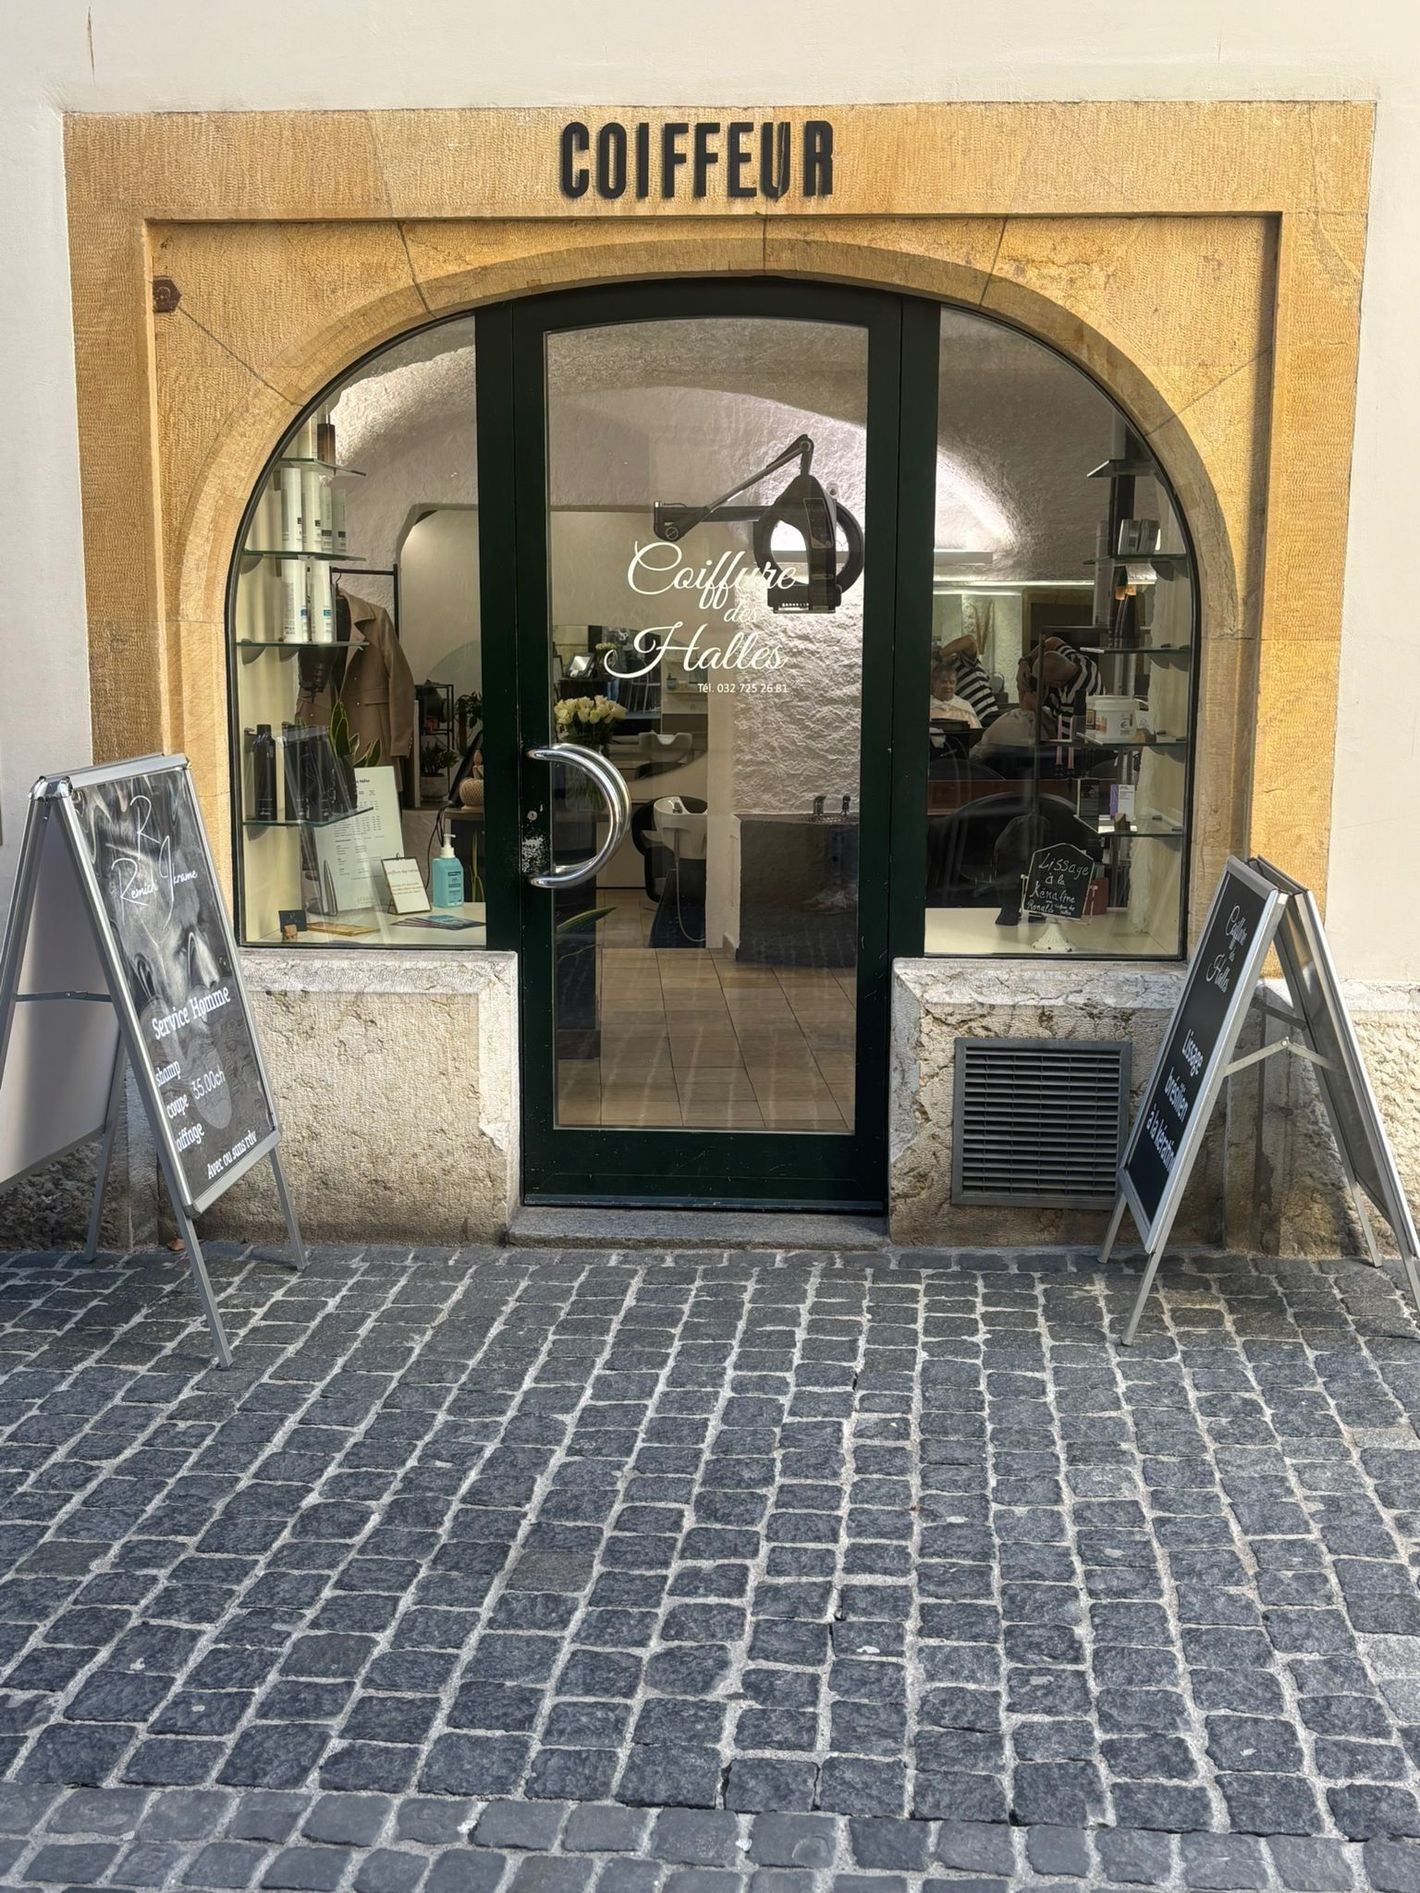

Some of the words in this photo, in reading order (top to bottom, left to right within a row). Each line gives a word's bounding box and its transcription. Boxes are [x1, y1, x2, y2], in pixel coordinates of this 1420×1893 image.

[561, 120, 834, 199] COIFFEUR
[627, 541, 797, 610] Coiffure
[723, 602, 757, 622] des
[603, 621, 789, 679] Halles
[697, 682, 715, 693] Tél.
[716, 683, 736, 694] 032
[739, 683, 758, 694] 725
[1038, 852, 1089, 880] Lissage
[151, 1007, 191, 1040] Service
[190, 987, 230, 1020] Homme
[1181, 1028, 1204, 1077] Lissage
[166, 1093, 189, 1119] coupe
[175, 1122, 205, 1152] oiffage
[207, 1157, 224, 1180] Avec
[222, 1151, 233, 1167] ou
[231, 1139, 247, 1160] sans
[244, 1129, 258, 1149] rdv
